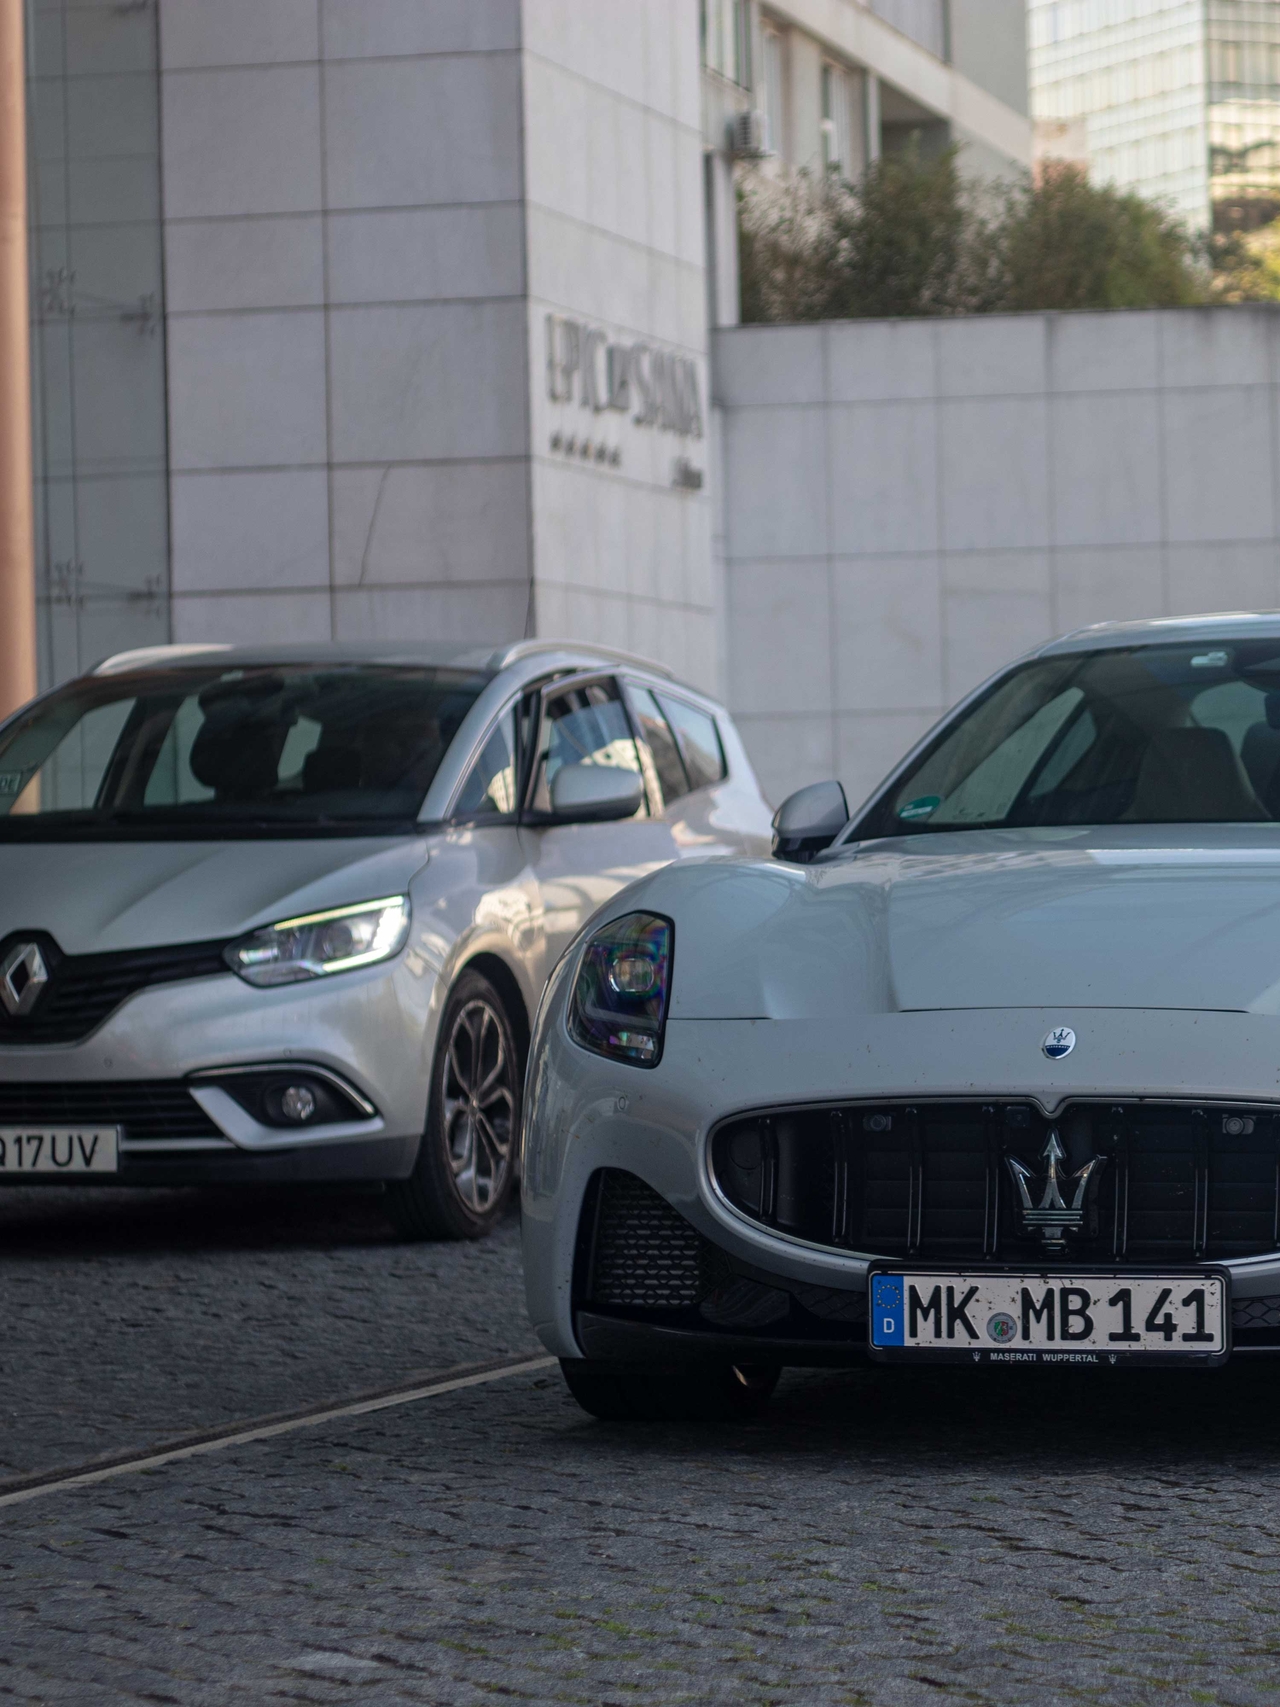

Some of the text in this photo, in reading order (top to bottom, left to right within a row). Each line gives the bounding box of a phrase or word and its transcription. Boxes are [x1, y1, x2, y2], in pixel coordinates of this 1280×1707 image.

[14, 1135, 44, 1167] 17
[51, 1135, 98, 1168] UV
[883, 1317, 895, 1333] D
[908, 1284, 980, 1339] MK
[1021, 1287, 1095, 1342] MB
[1108, 1288, 1215, 1343] 141
[990, 1352, 1099, 1363] MASERATI WUPPERTAL
